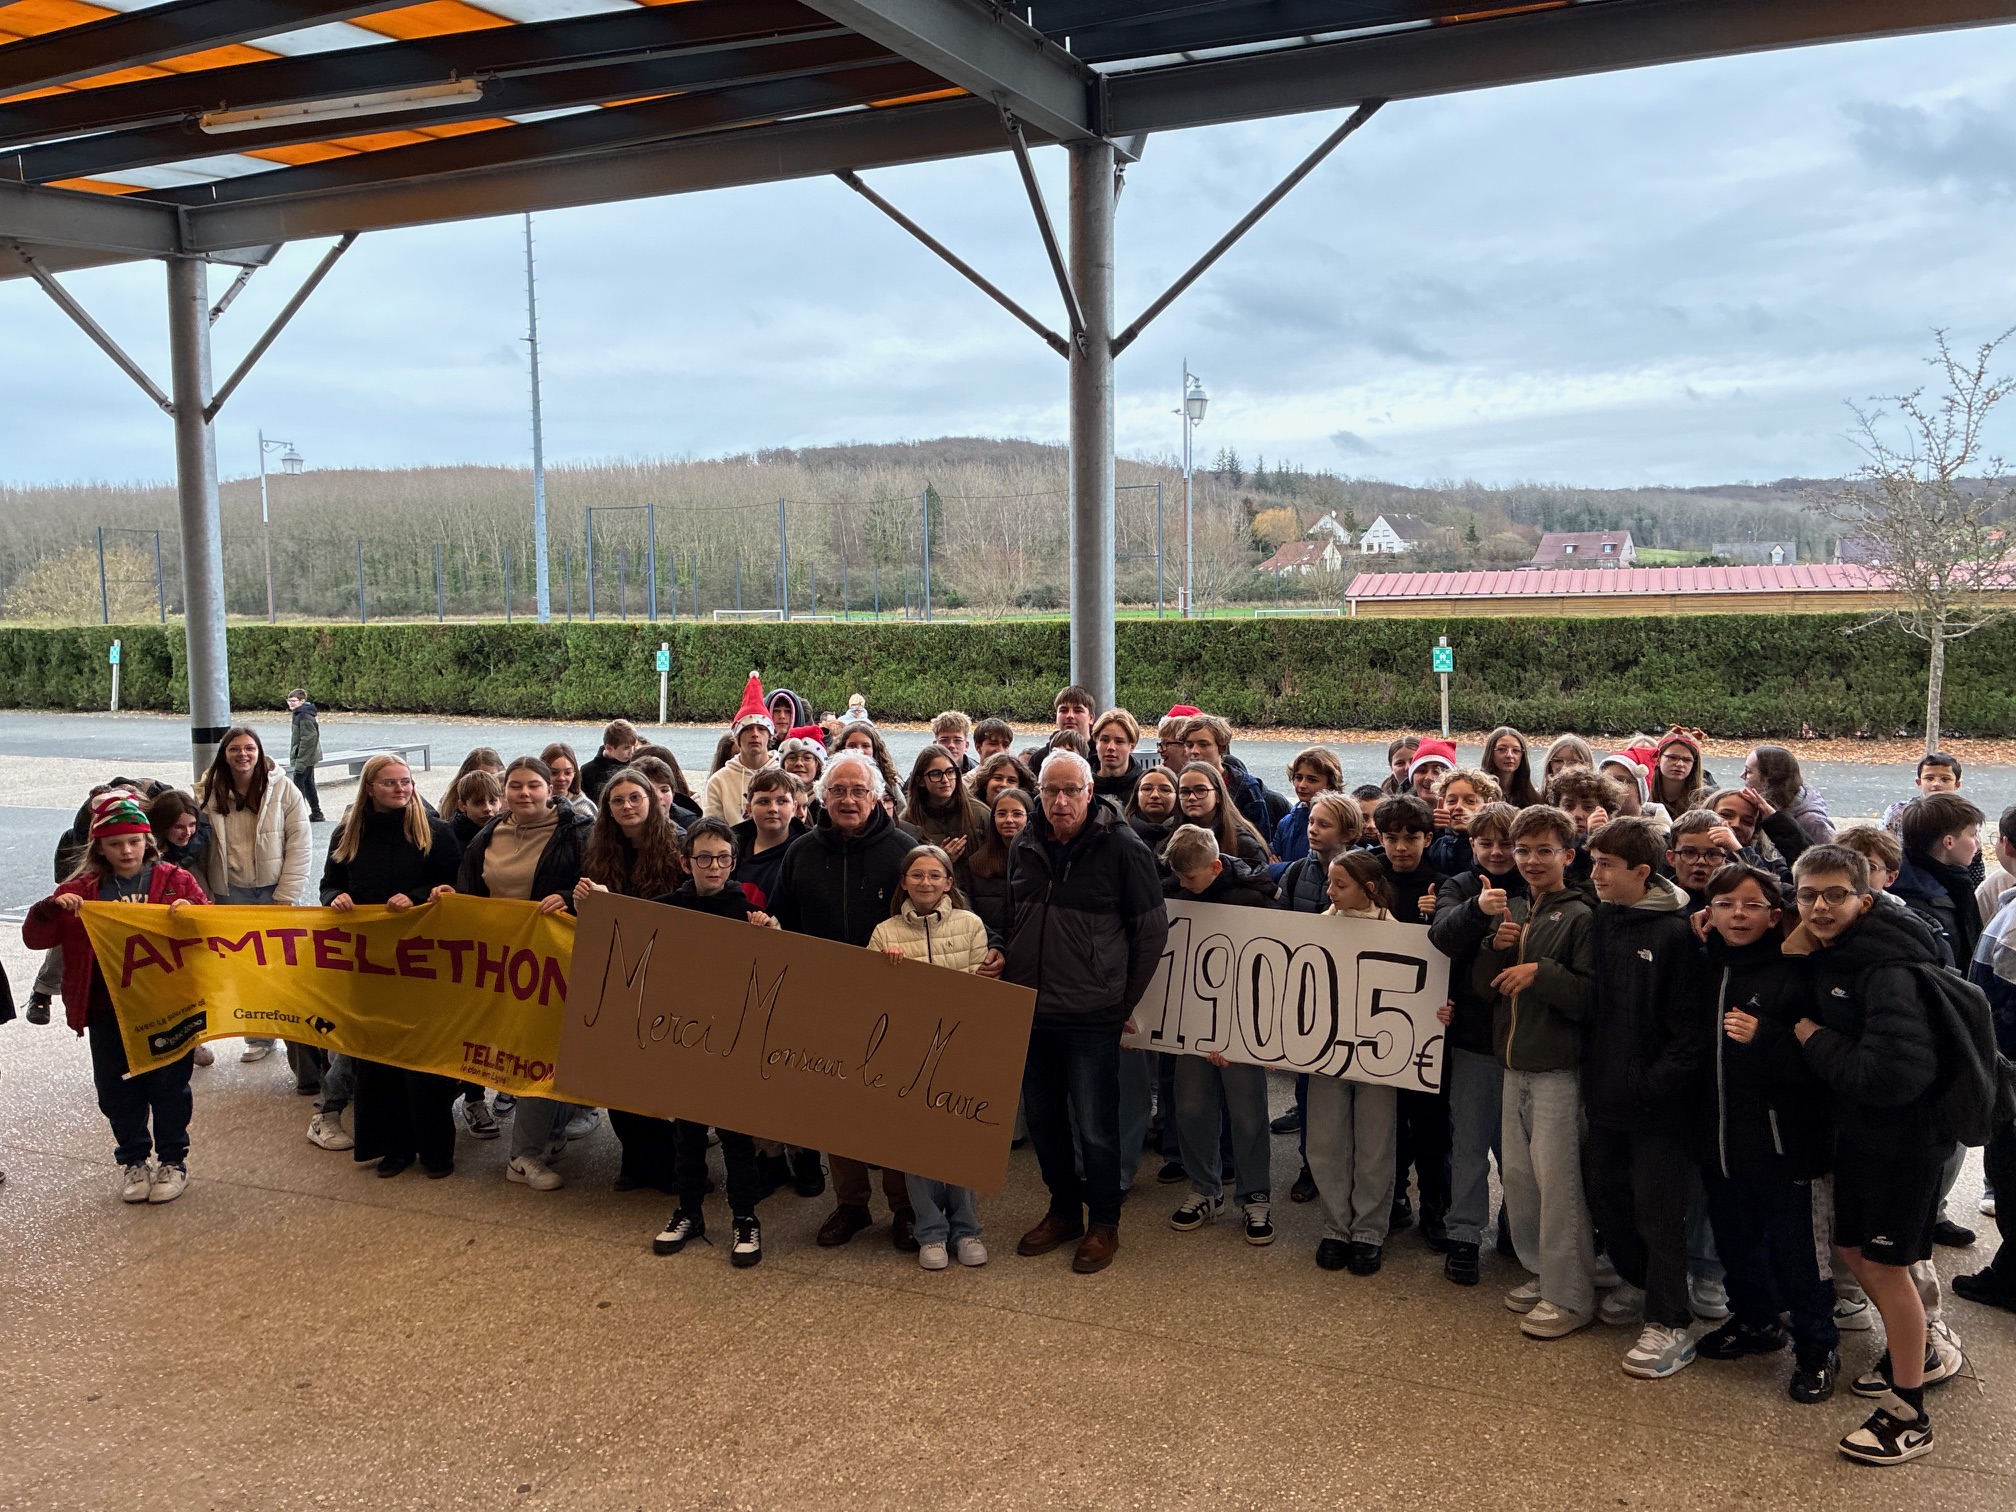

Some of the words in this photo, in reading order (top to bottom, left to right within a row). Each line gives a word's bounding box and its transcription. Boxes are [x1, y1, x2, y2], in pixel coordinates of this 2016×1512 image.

[233, 1008, 301, 1024] Carrefour
[584, 918, 715, 1055] Merci
[722, 958, 847, 1080] Monsieur
[857, 1013, 889, 1088] le
[898, 1018, 1000, 1126] Maire
